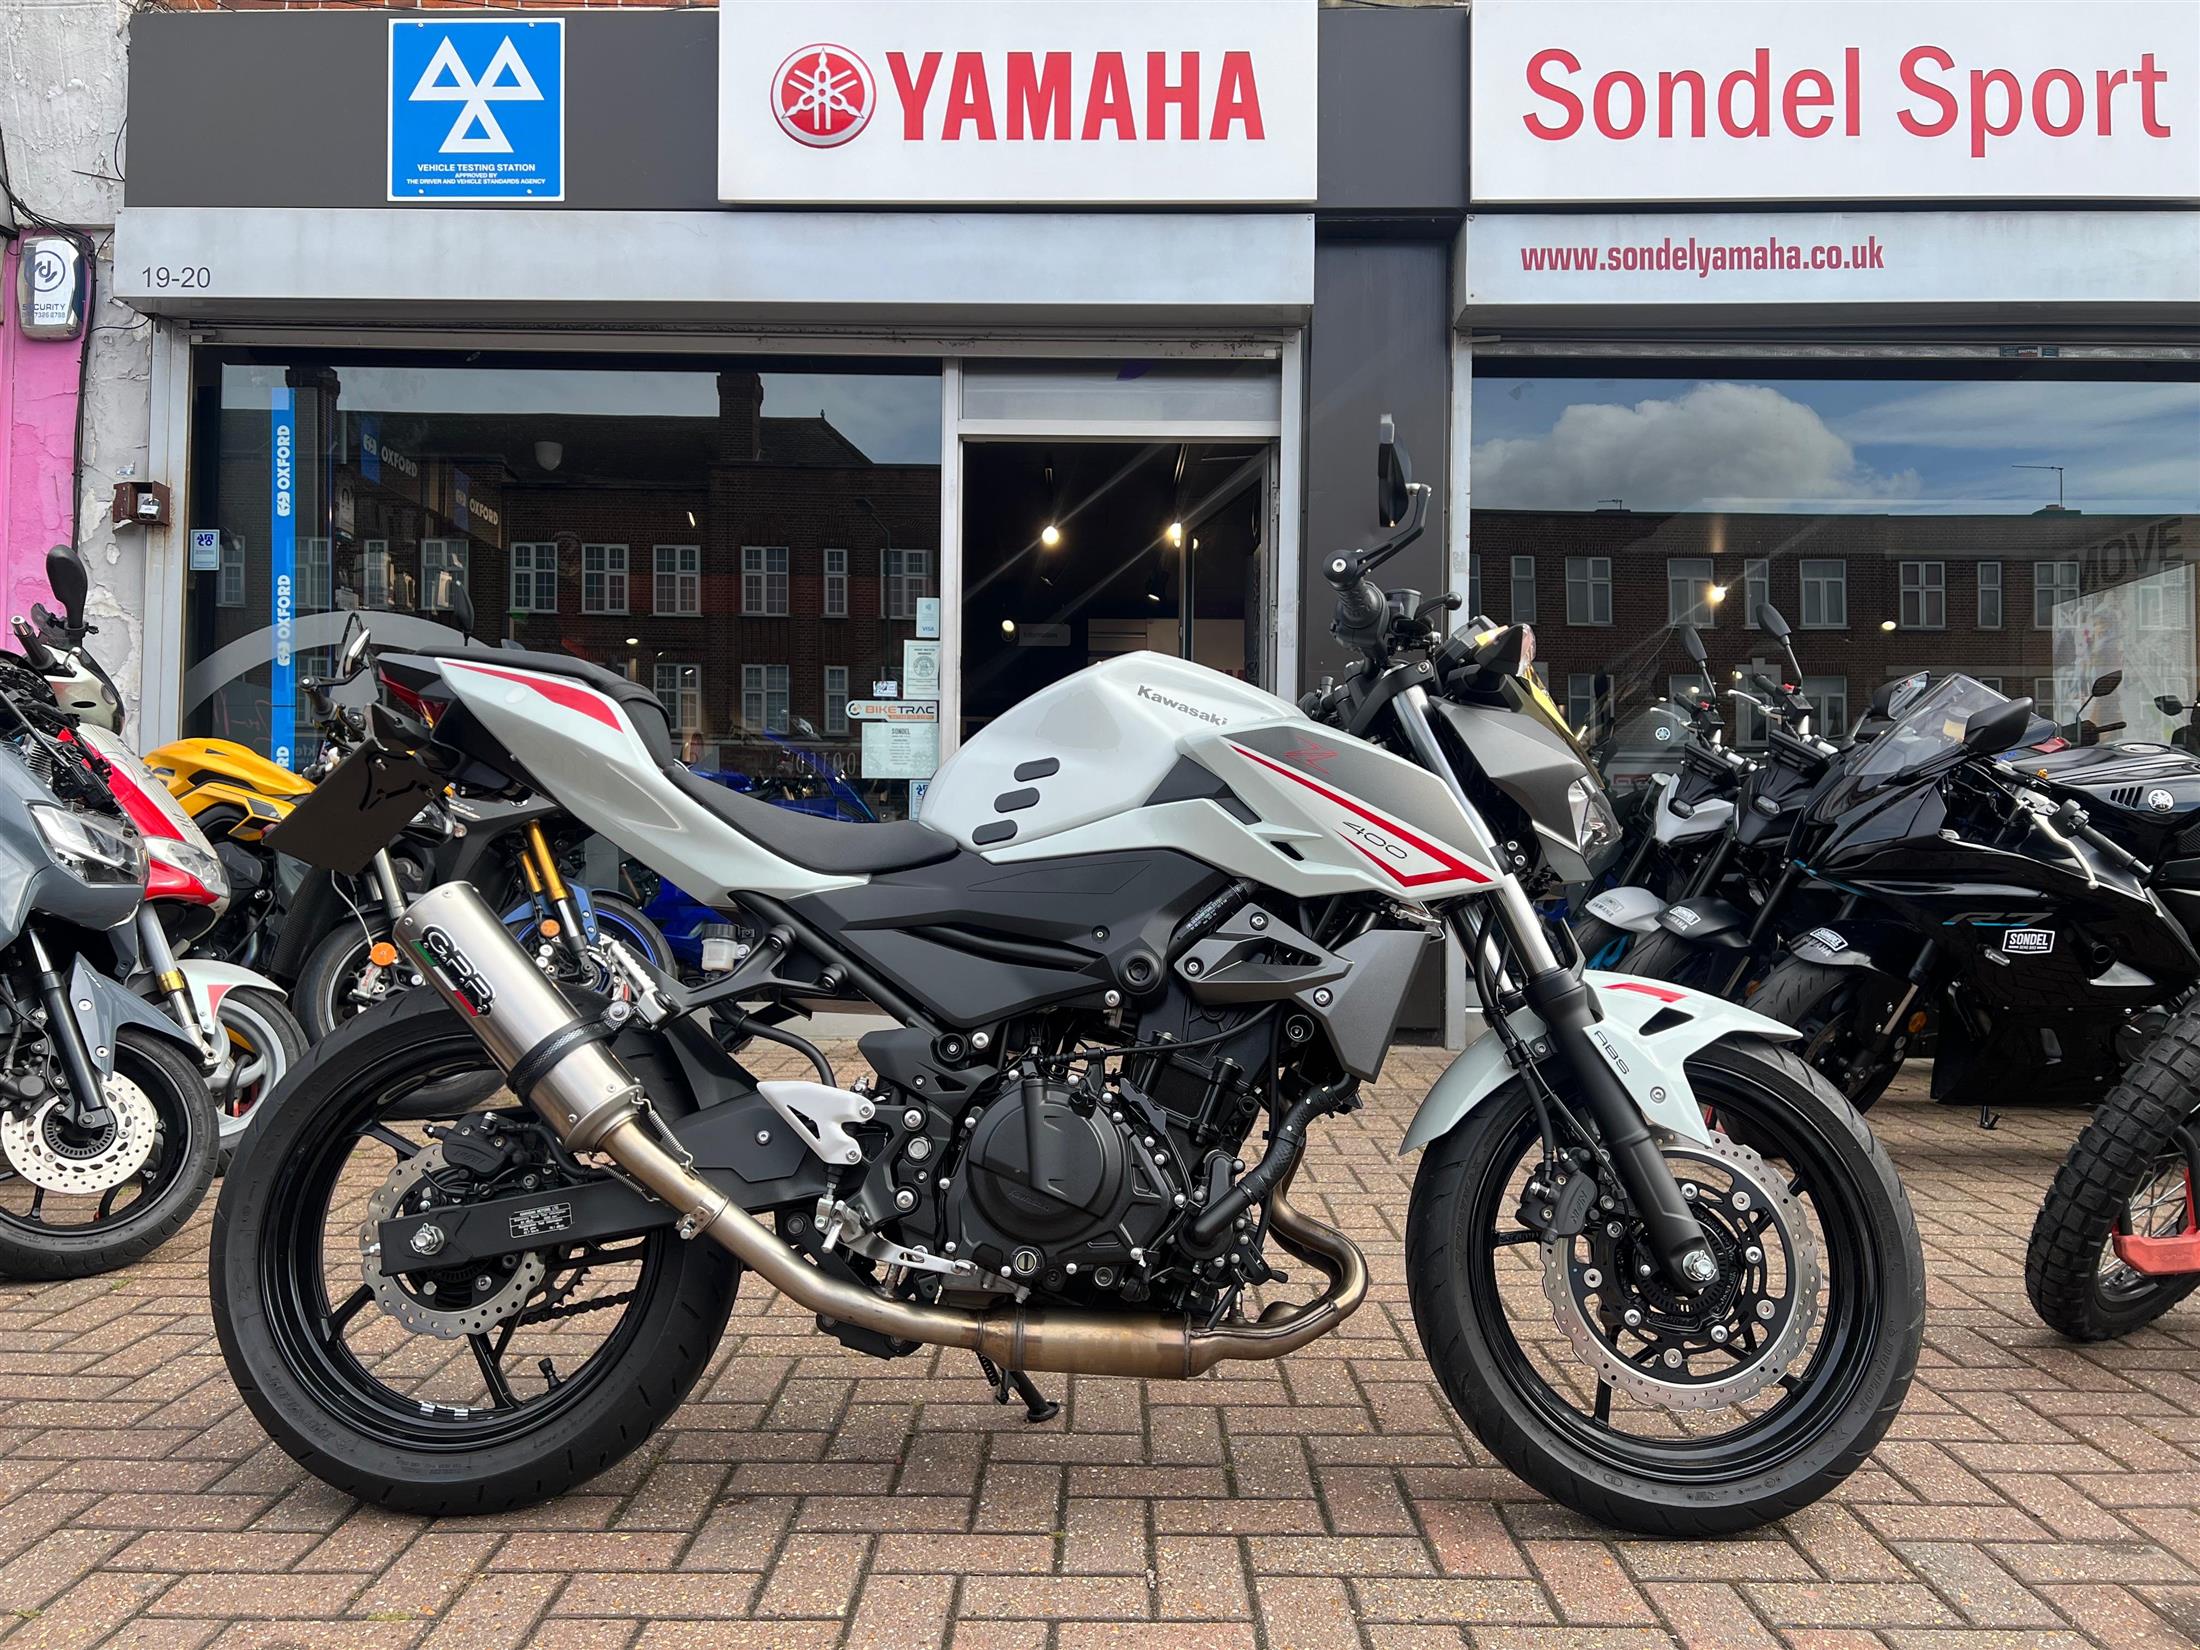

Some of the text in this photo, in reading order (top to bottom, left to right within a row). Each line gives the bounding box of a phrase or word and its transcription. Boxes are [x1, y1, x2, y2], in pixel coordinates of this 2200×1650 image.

[885, 50, 1267, 141] YAMAHA
[1522, 45, 2172, 159] Sondel Sport
[417, 163, 536, 172] VEHICLE TESTING STATION
[141, 265, 212, 289] 19-20
[1520, 235, 1885, 279] www.sondelyamaha.co.uk
[276, 424, 291, 491] OXFORD
[380, 445, 418, 478] OXFORD
[468, 498, 499, 526] OXFORD
[276, 574, 291, 640] OXFORD
[864, 705, 935, 715] BIKETRAC
[1136, 684, 1229, 727] Kawasaki
[1341, 820, 1409, 860] 400
[1941, 911, 2054, 927] R7
[2009, 932, 2049, 946] SONDEL
[1593, 1029, 1631, 1075] ABS
